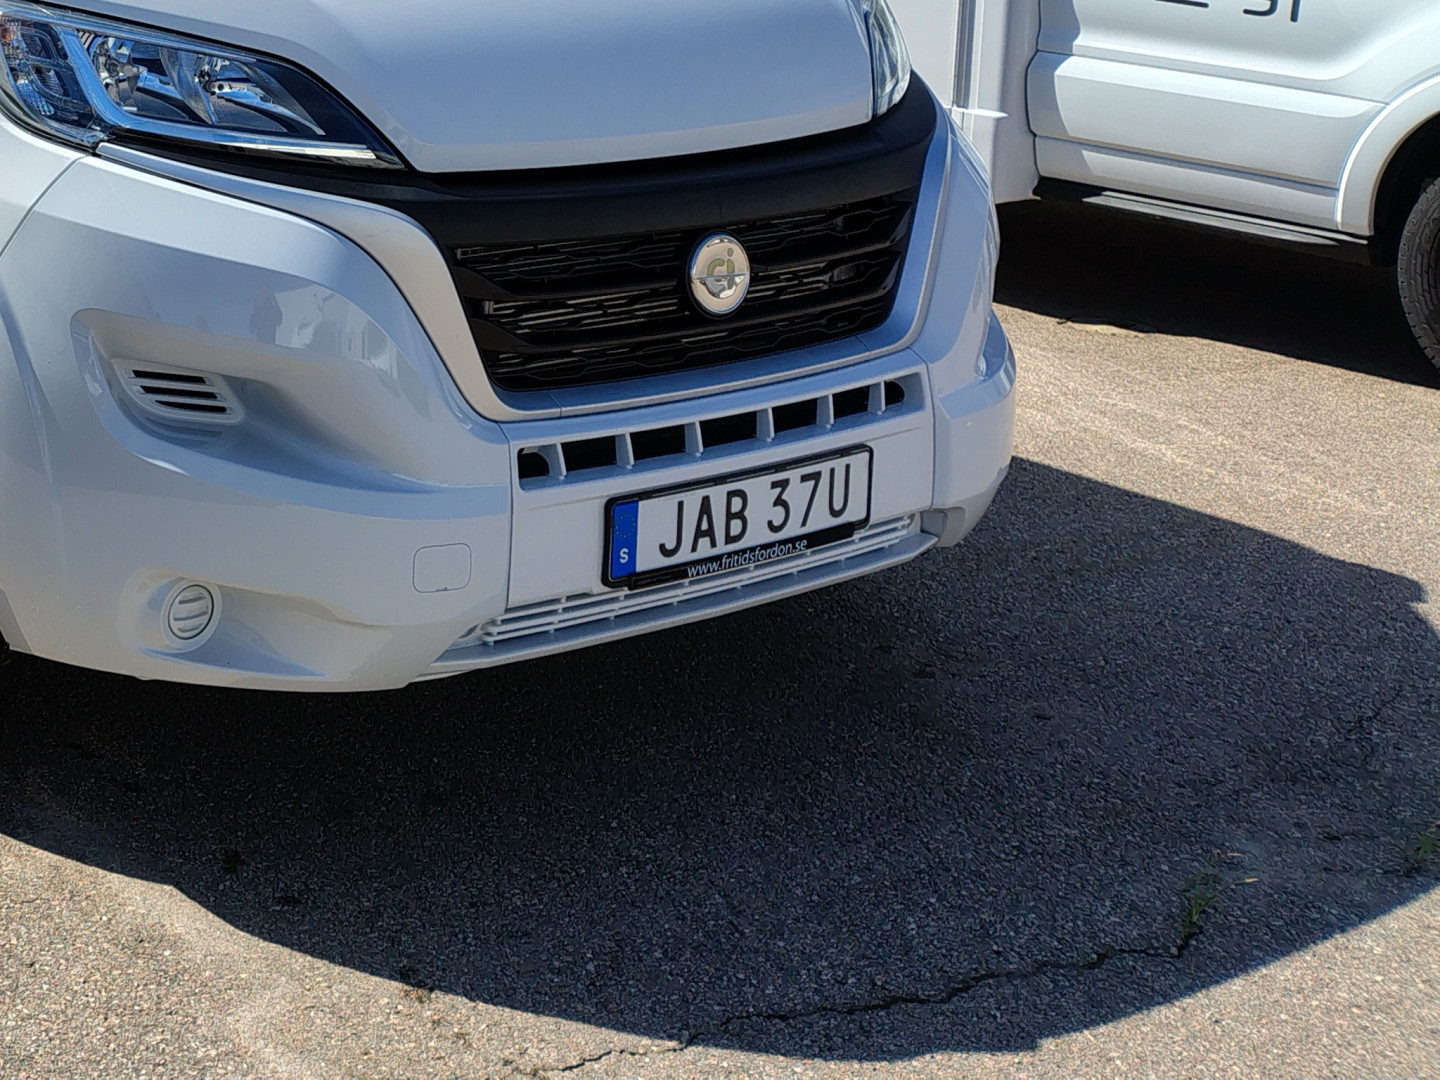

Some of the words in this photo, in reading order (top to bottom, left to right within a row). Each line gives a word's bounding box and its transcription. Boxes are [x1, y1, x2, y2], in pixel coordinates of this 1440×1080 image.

[659, 488, 749, 558] JAB
[767, 463, 852, 534] 37U
[619, 547, 630, 564] S
[687, 538, 808, 578] www.fritidsfordon.se
